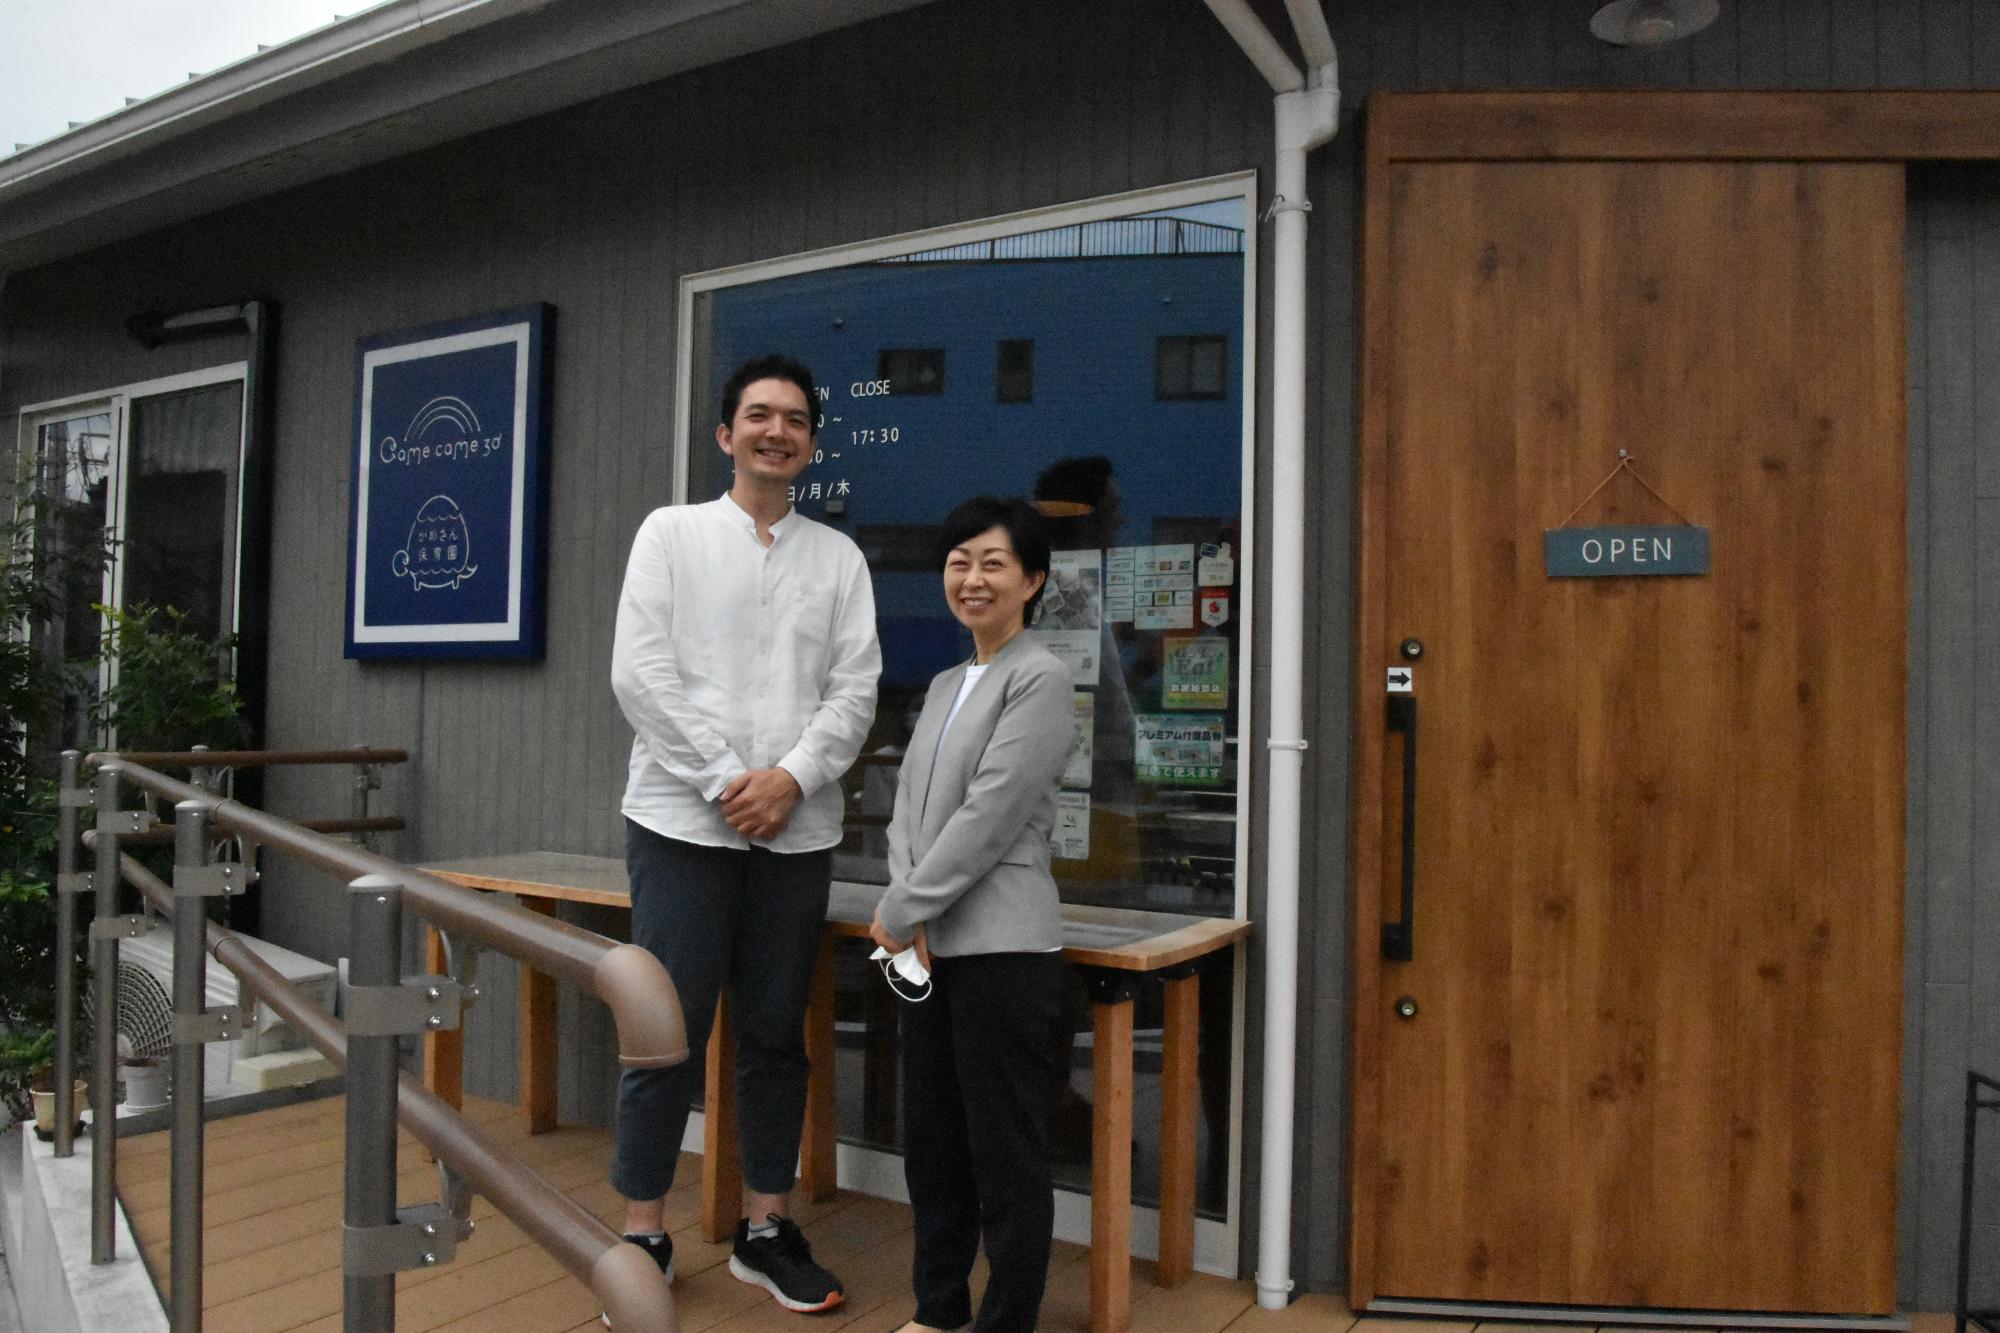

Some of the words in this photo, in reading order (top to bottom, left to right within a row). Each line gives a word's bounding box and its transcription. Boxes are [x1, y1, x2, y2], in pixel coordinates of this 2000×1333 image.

[851, 380, 891, 398] CLOSE
[851, 427, 900, 445] 17:30
[1582, 537, 1672, 564] OPEN
